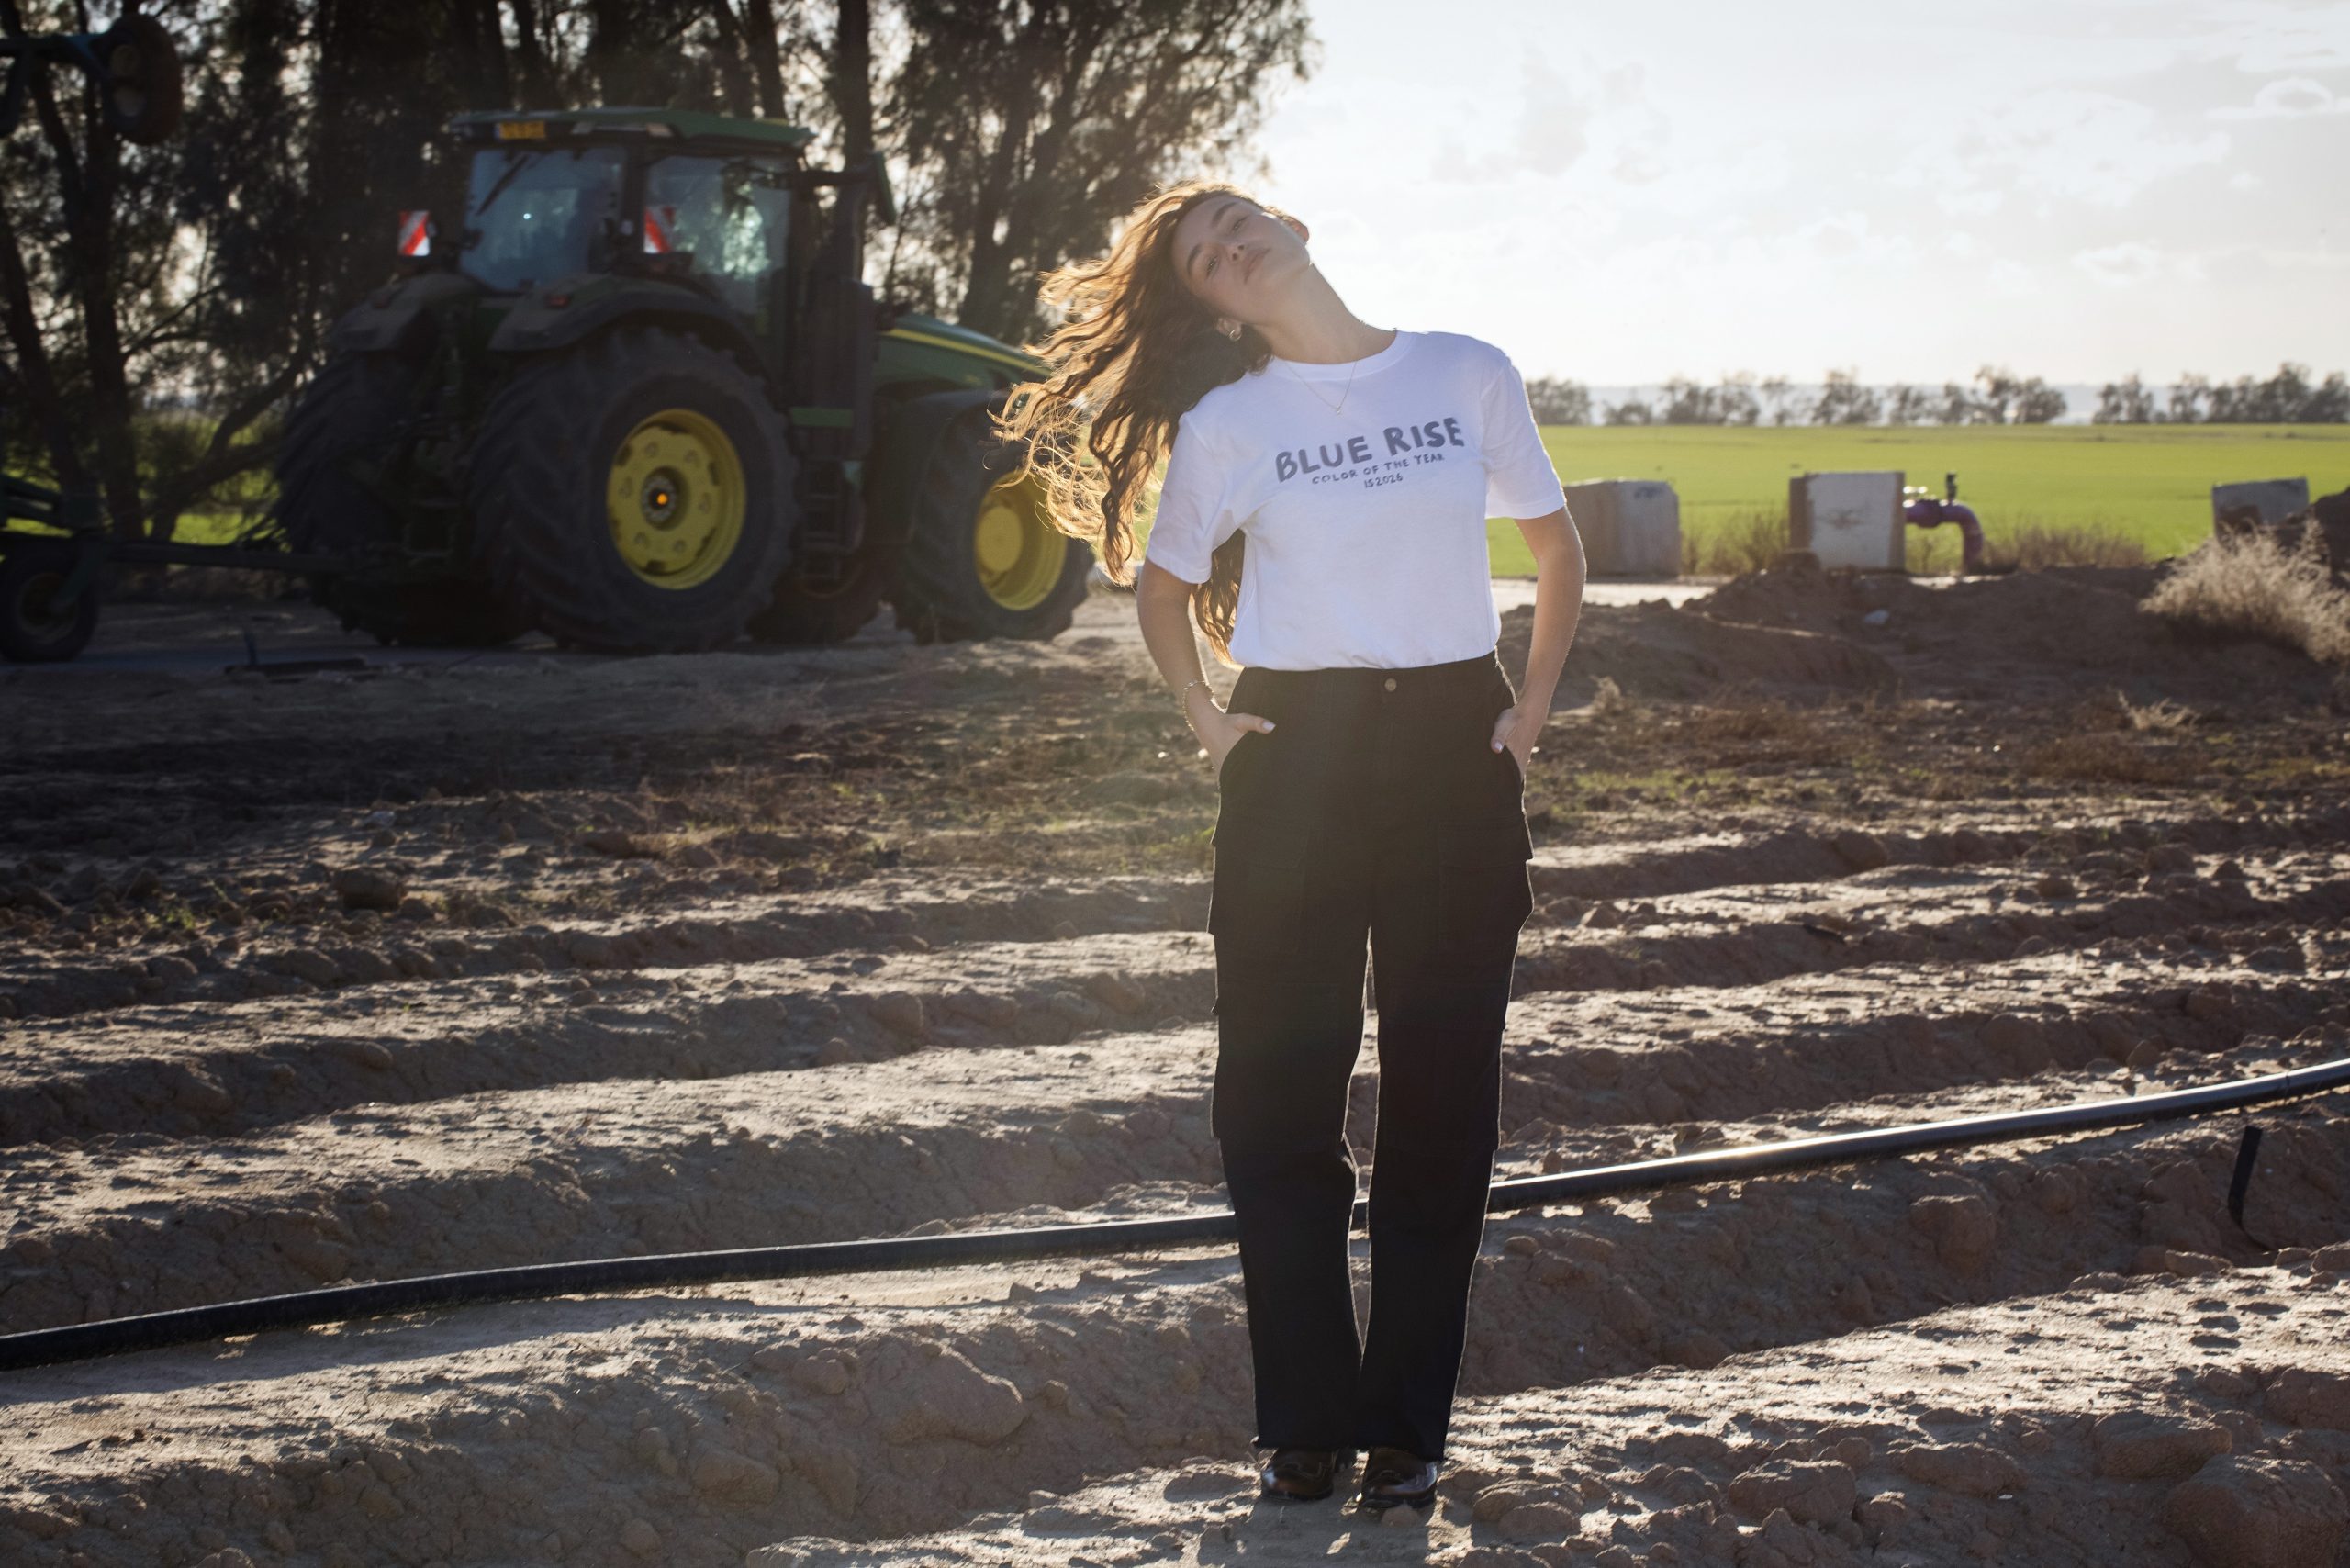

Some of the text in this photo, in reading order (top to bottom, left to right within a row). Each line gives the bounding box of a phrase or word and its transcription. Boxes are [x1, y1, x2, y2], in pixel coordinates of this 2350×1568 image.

[1275, 417, 1465, 483] BLUE RISE
[1312, 453, 1445, 484] COLOR OF THE YEAR
